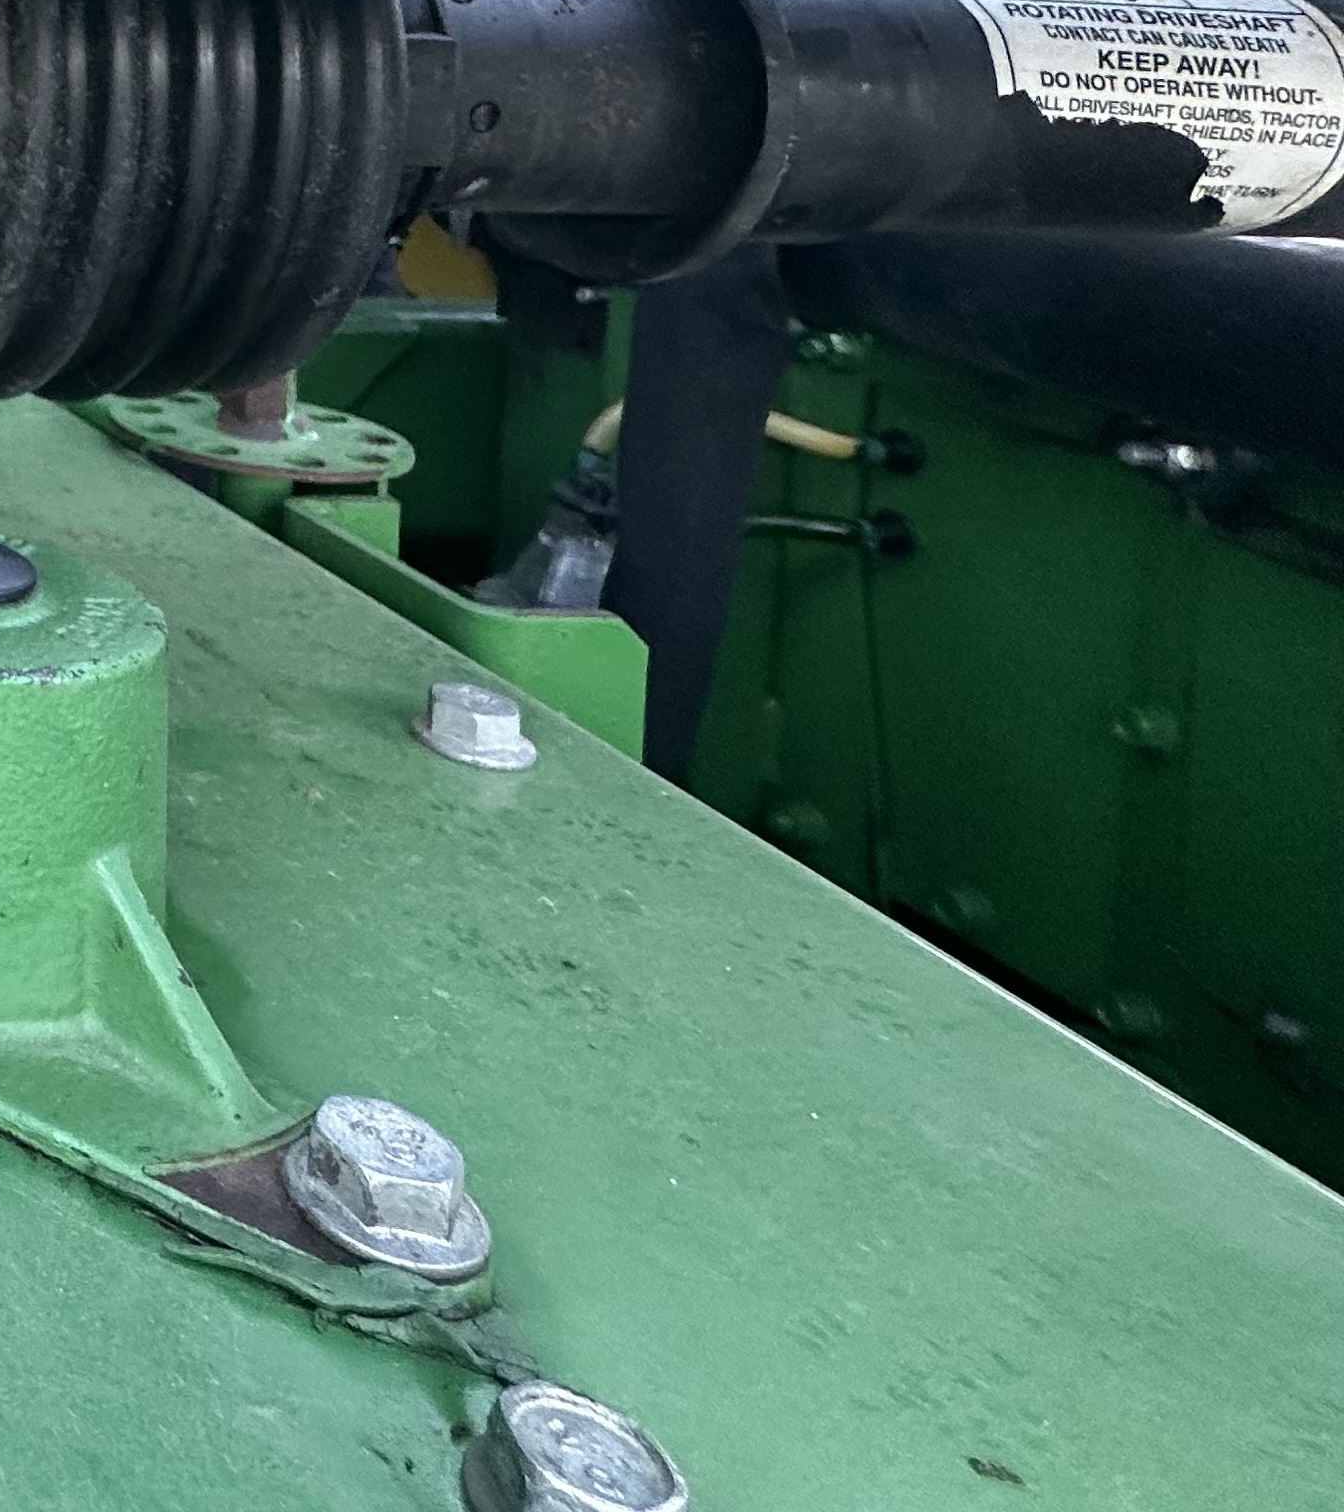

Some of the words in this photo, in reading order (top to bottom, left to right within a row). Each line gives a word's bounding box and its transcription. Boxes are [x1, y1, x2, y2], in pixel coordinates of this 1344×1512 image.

[1003, 2, 1134, 24] ROTATING
[1136, 8, 1297, 33] DRIVESHAFT
[1042, 24, 1124, 44] CONTACT
[1127, 28, 1167, 47] CAN
[1168, 31, 1232, 51] CAUSE
[1231, 36, 1291, 54] DEATH
[1097, 48, 1170, 72] KEEP
[1176, 54, 1260, 79] AWAY!
[1040, 70, 1071, 89] DO
[1075, 73, 1118, 92] NOT
[1123, 76, 1220, 100] OPERATE
[1069, 97, 1176, 119] DRIVESHAFT
[1179, 105, 1255, 127] GUARDS,
[1260, 110, 1341, 131] TRACTOR
[1181, 123, 1255, 143] SHIELDS
[1256, 128, 1277, 144] IN
[1278, 130, 1338, 149] PLACE
